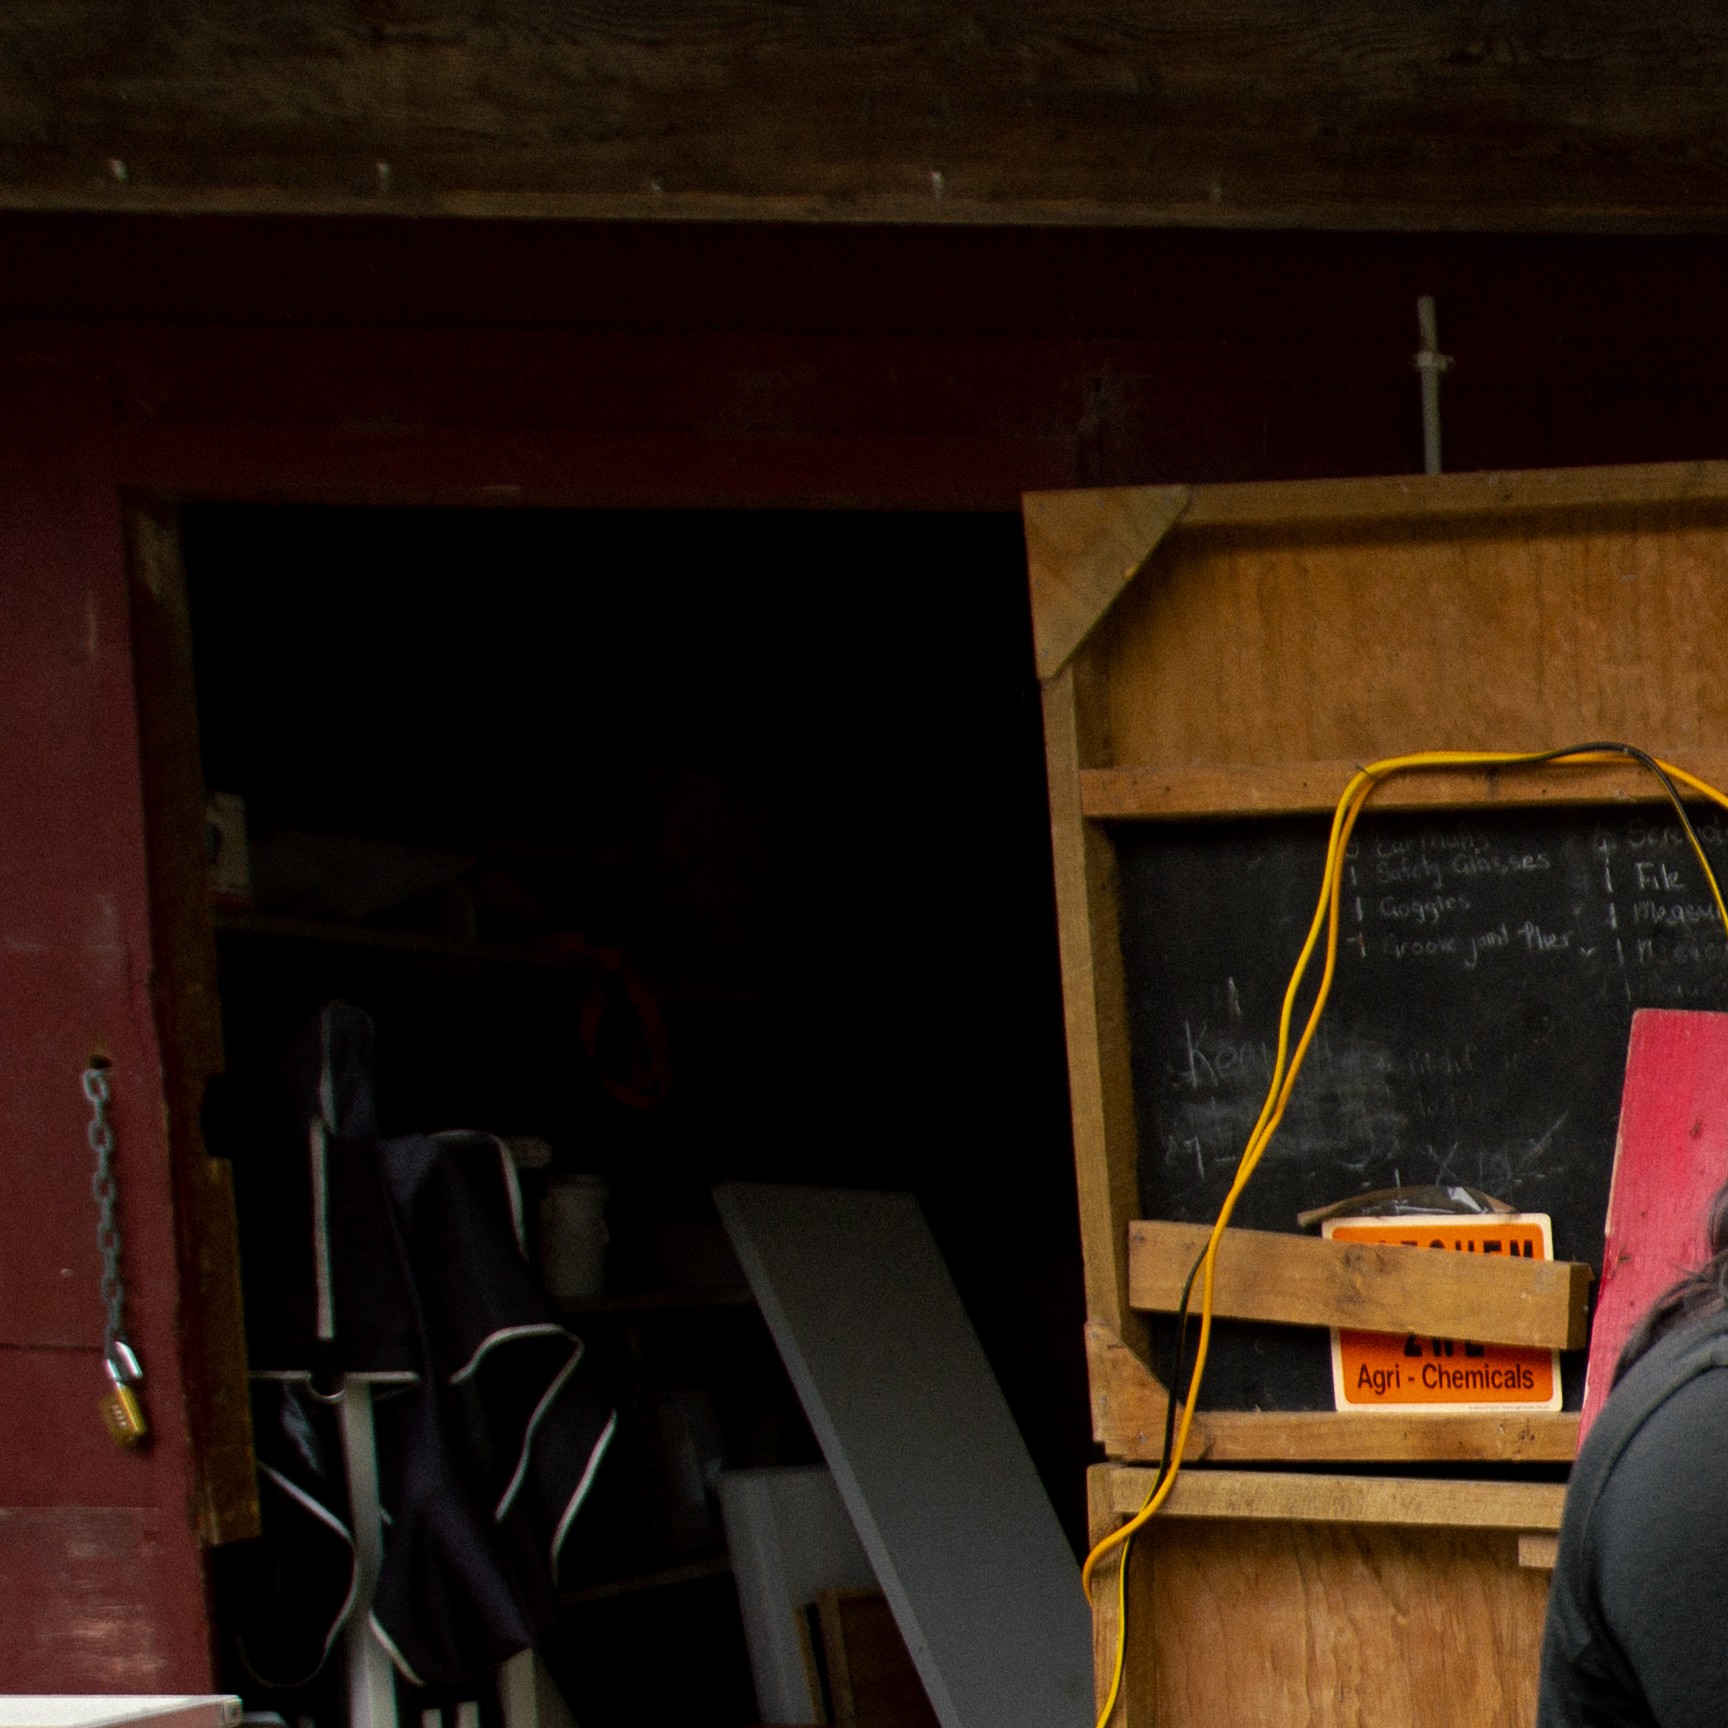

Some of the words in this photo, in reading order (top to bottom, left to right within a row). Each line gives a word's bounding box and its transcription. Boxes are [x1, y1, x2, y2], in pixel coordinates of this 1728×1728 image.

[1634, 861, 1687, 890] File
[1379, 895, 1472, 925] Goggles
[1357, 1362, 1401, 1396] Agri
[1421, 1362, 1535, 1391] Chemicals
